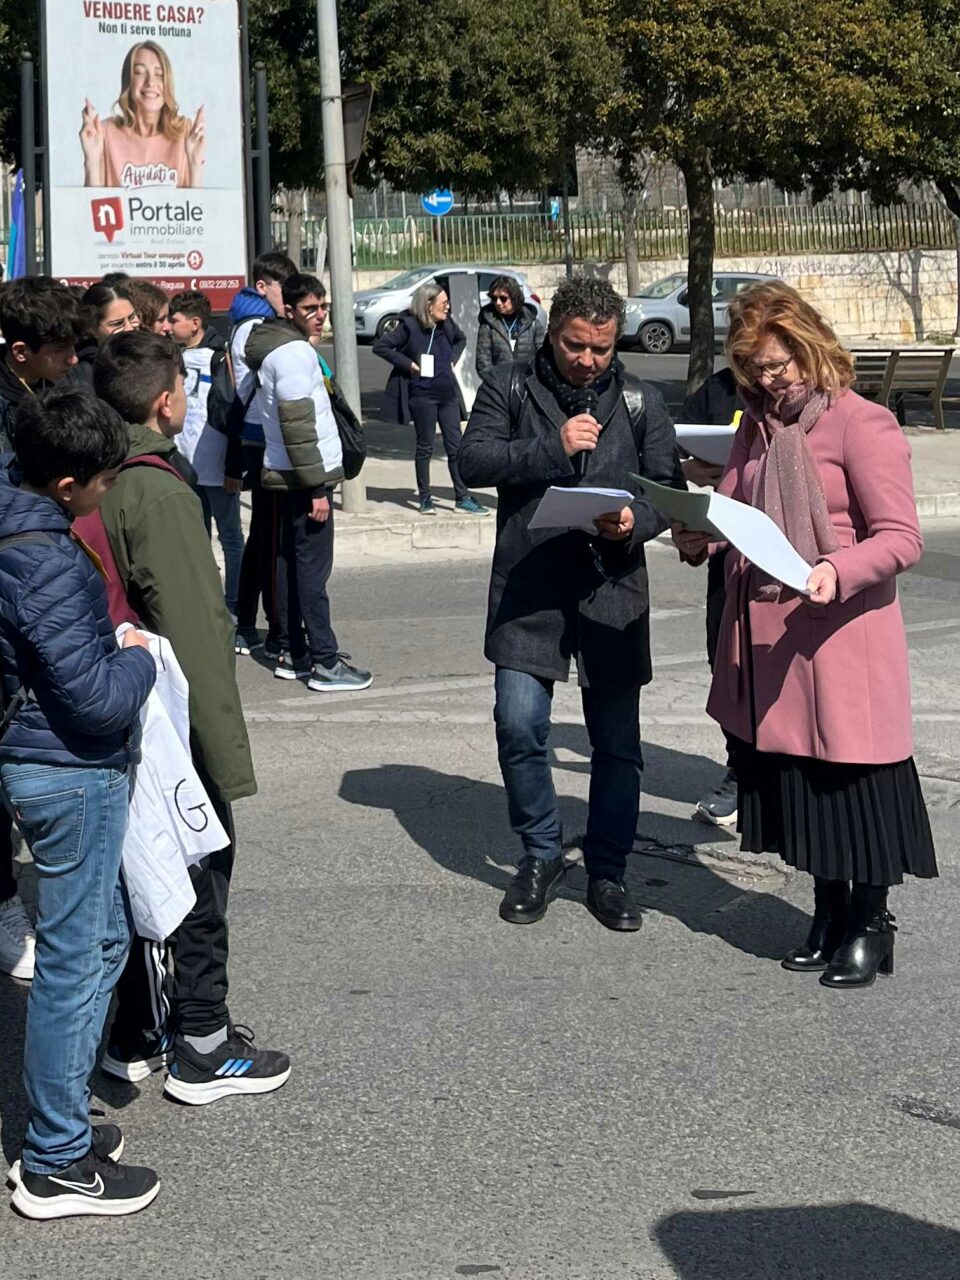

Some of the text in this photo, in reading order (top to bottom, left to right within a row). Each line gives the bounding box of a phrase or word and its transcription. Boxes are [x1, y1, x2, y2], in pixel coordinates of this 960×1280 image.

[83, 0, 204, 24] VENDERE CASA?
[99, 22, 191, 37] Non ti serve fortuna
[124, 166, 176, 186] Affidati a
[128, 197, 203, 221] Portale
[130, 223, 204, 236] immobiliare
[121, 251, 142, 259] Virtual
[144, 251, 157, 259] Tour
